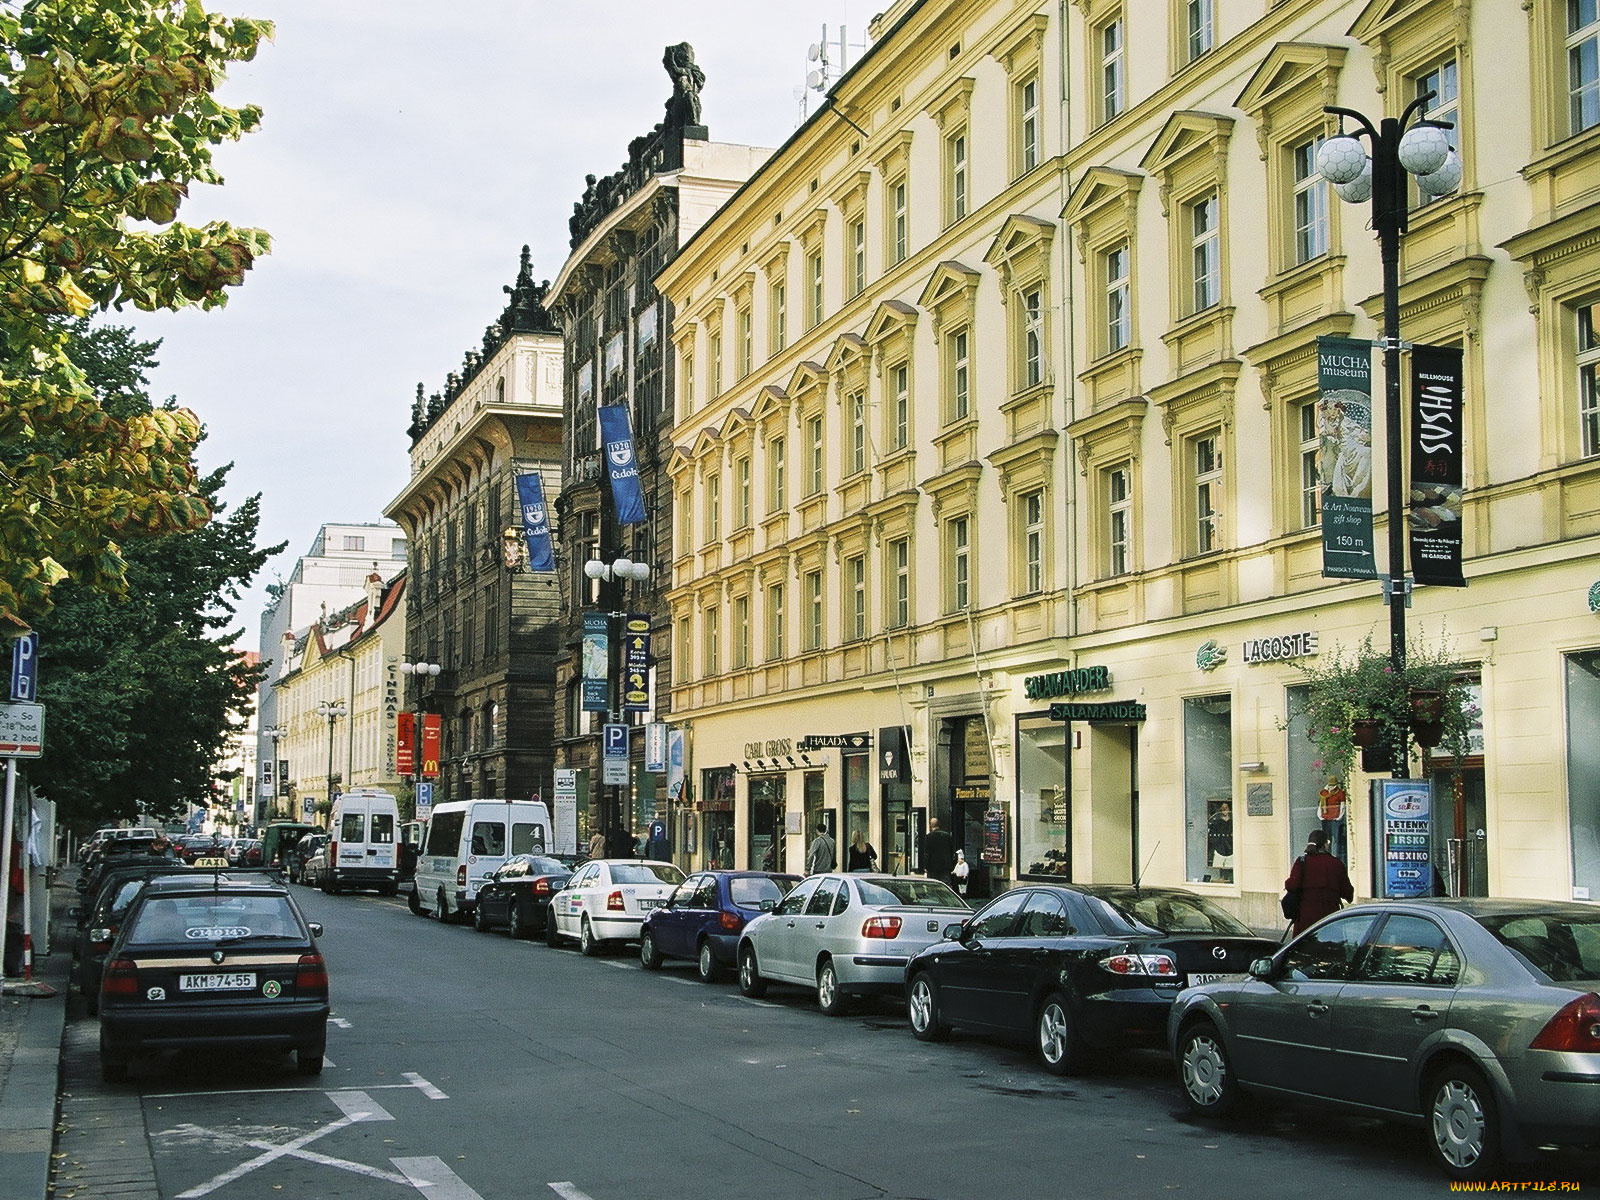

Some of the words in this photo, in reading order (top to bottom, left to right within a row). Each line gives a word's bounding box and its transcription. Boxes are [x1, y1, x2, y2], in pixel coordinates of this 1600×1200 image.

[1320, 355, 1369, 369] MUCHA
[1323, 366, 1368, 379] museum
[610, 442, 630, 452] 1920
[1331, 503, 1342, 511] Art
[1333, 514, 1346, 525] gift
[1346, 514, 1362, 526] shop
[1336, 535, 1353, 546] 150
[1355, 539, 1364, 547] m
[1242, 632, 1312, 663] LACOSTE
[19, 635, 32, 674] P
[1024, 665, 1108, 699] SALAMANDER
[385, 664, 397, 720] CINEMAS
[21, 712, 33, 720] So
[1053, 705, 1146, 719] SALAMANDER
[12, 733, 18, 742] 2
[610, 728, 623, 747] P
[810, 737, 848, 746] HALADA
[744, 742, 764, 760] CARL
[765, 738, 791, 757] GROSS
[420, 784, 429, 798] P
[1387, 820, 1429, 829] LETENKY
[529, 826, 541, 839] 4
[654, 826, 663, 836] P
[380, 833, 390, 842] 11
[1394, 836, 1426, 845] IRSKO
[1387, 851, 1429, 860] MEXIKO
[200, 858, 224, 866] TAXI
[185, 975, 208, 988] AKM
[216, 974, 251, 987] 74-55
